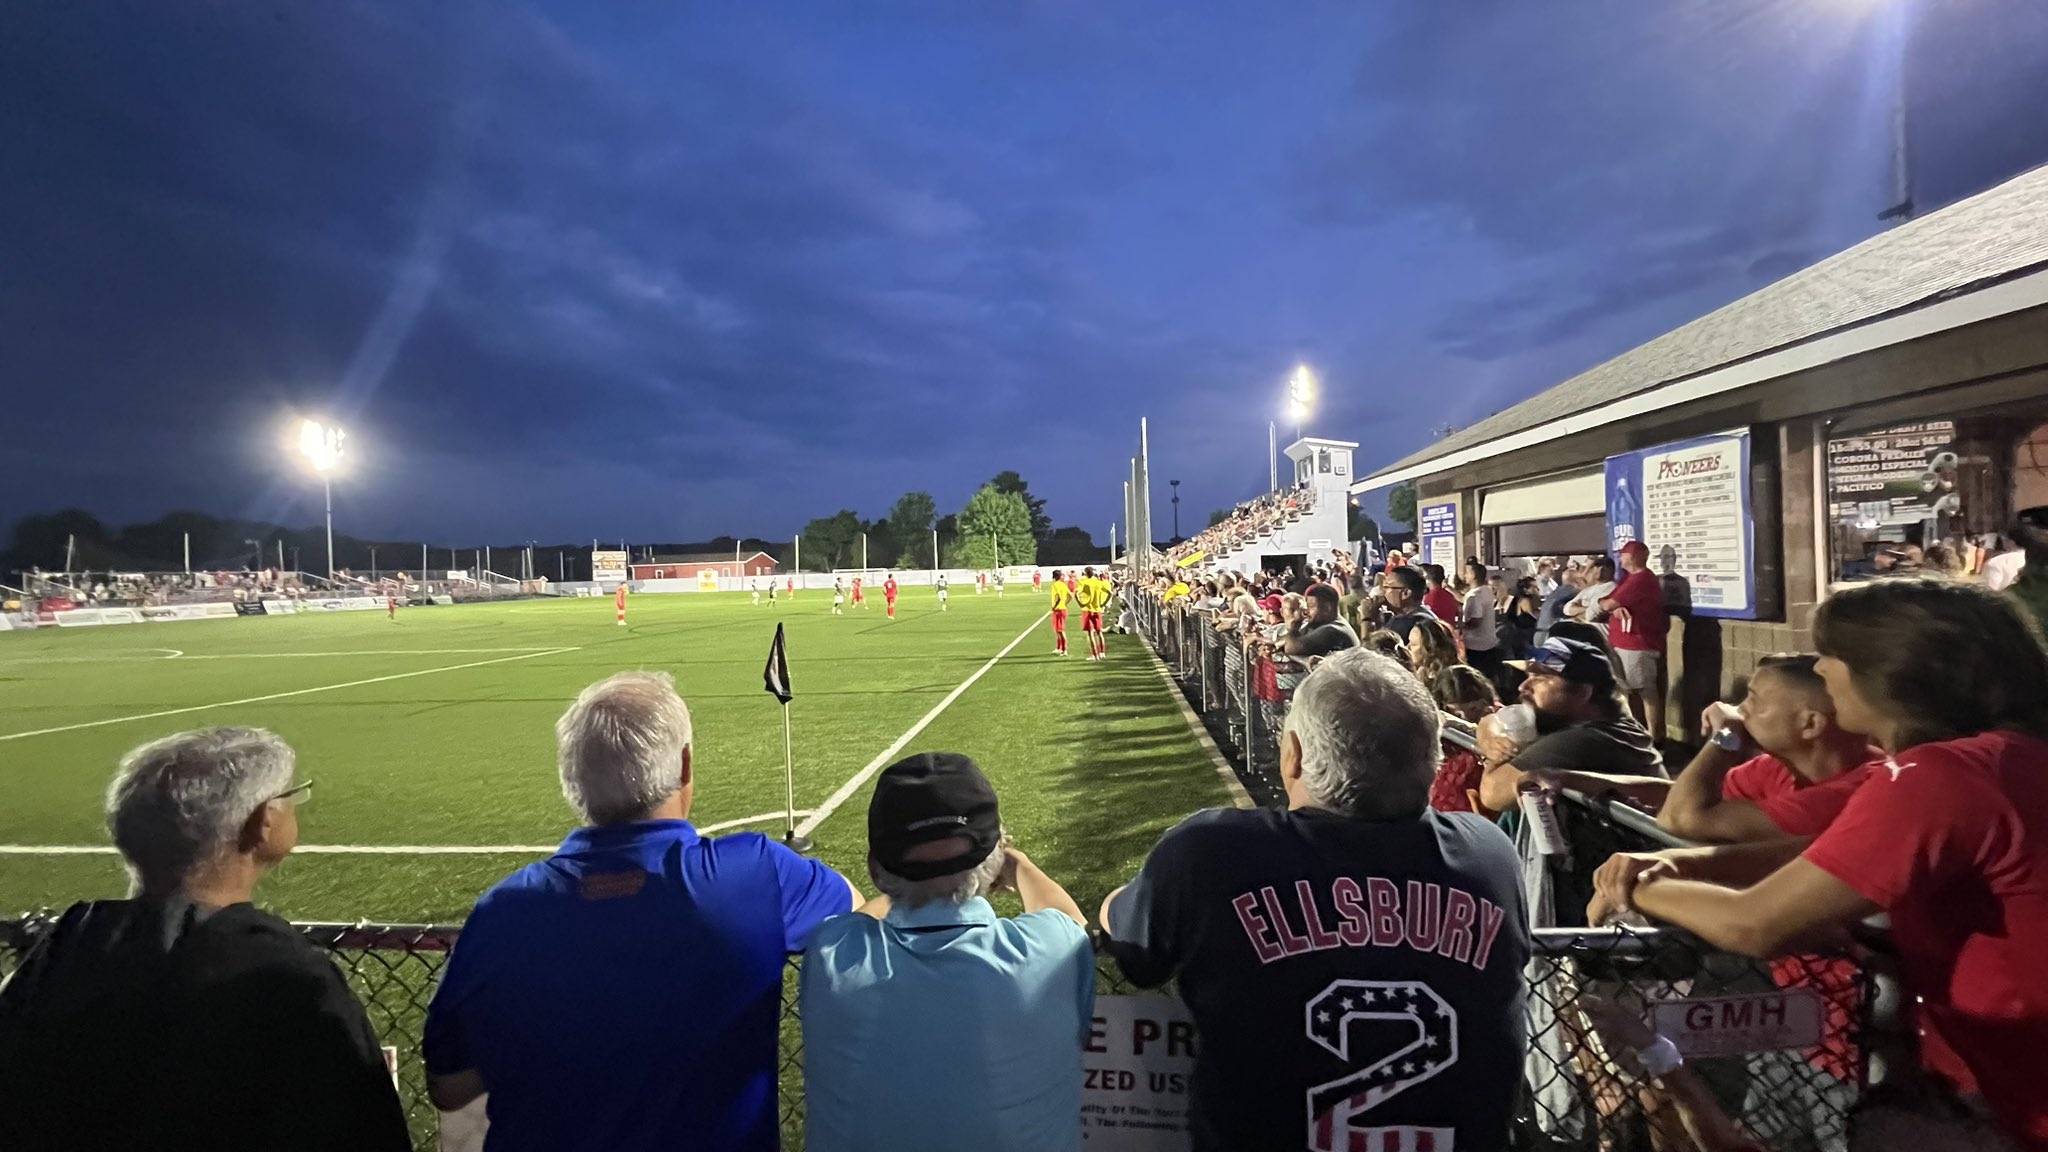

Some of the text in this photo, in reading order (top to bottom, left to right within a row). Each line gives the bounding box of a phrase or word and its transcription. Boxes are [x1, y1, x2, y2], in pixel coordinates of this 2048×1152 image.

[1834, 454, 1878, 464] CORONA
[1835, 460, 1928, 473] MODELO ESPECIAL
[1836, 482, 1884, 493] PACIFICO
[1613, 523, 1635, 539] BUD
[1232, 876, 1504, 971] ELLSBURY
[1685, 999, 1786, 1032] GMH
[1150, 1072, 1187, 1094] US
